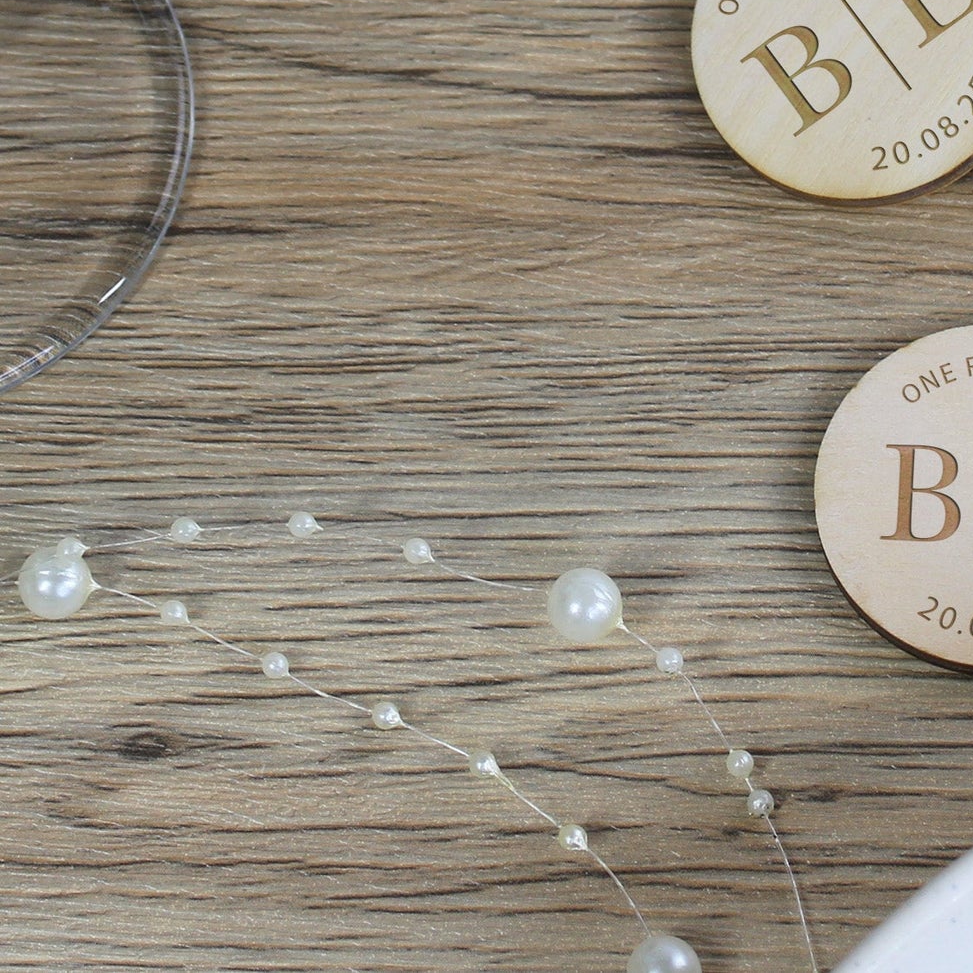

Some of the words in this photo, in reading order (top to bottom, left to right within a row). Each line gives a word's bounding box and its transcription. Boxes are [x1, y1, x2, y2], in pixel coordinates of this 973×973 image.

[740, 25, 853, 138] B
[902, 362, 957, 403] ONE
[879, 443, 962, 542] B
